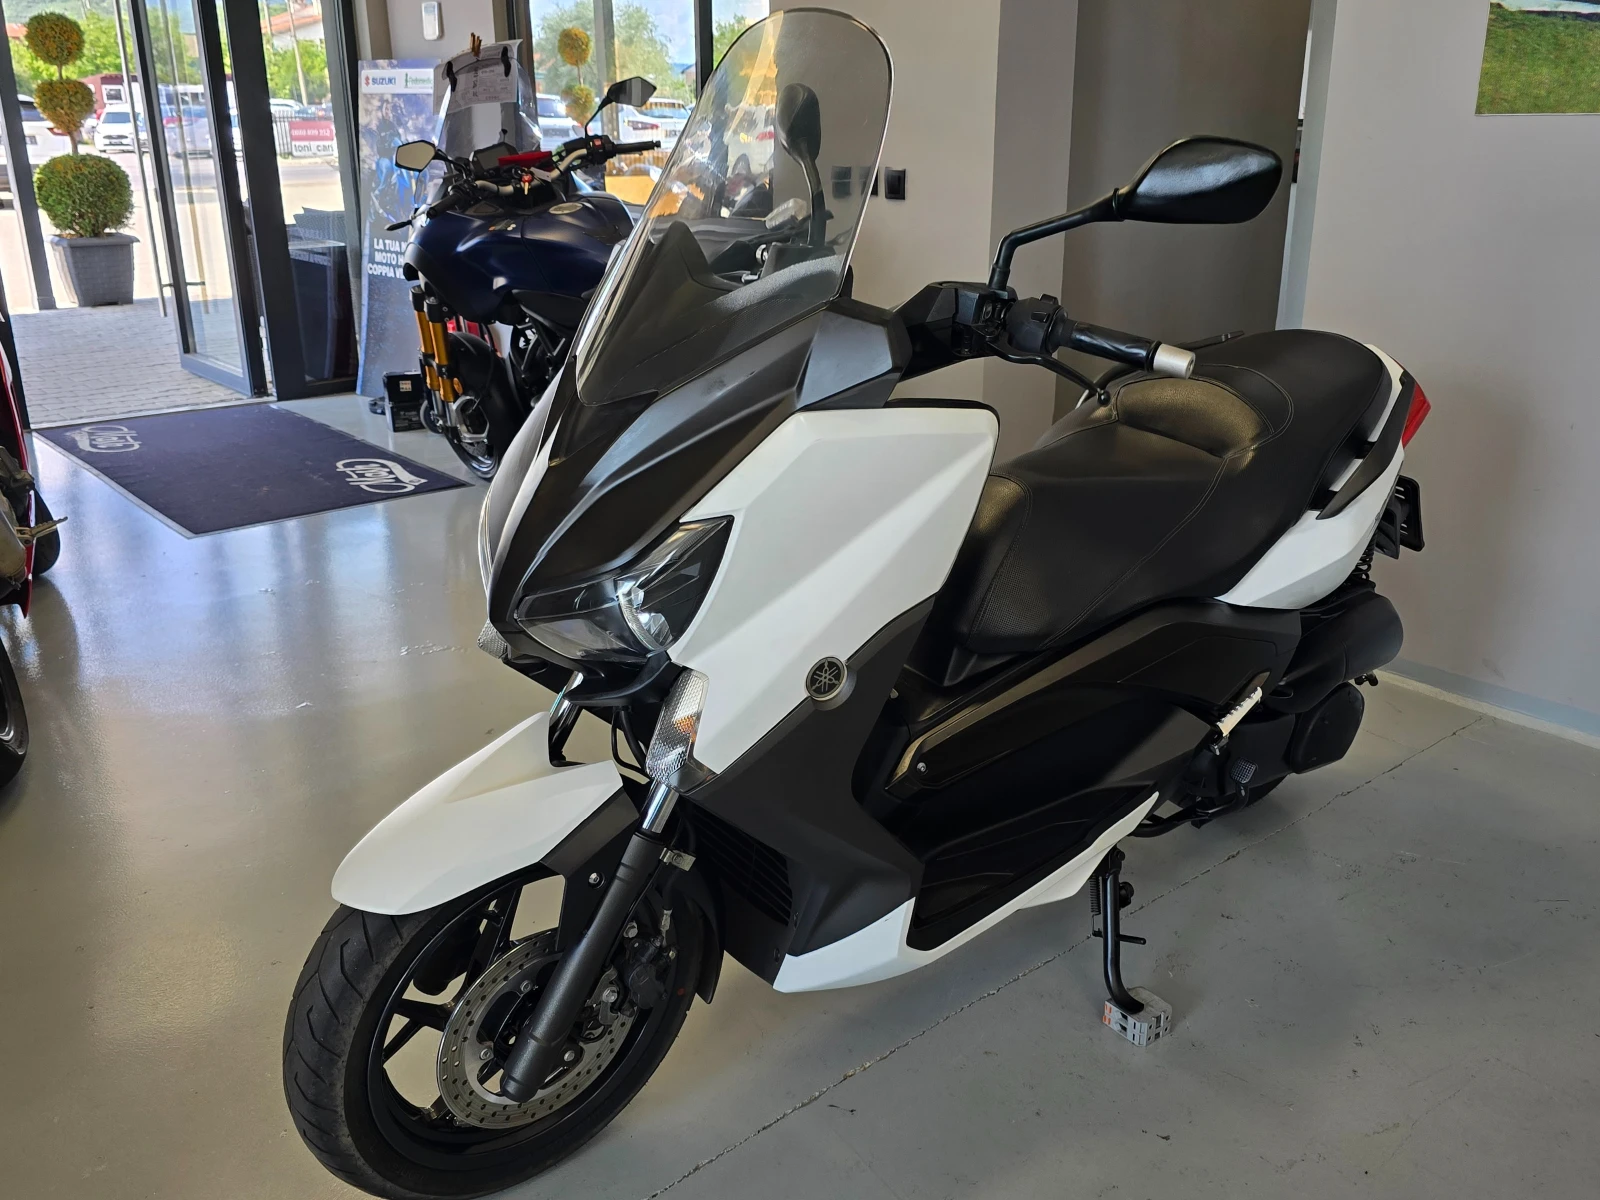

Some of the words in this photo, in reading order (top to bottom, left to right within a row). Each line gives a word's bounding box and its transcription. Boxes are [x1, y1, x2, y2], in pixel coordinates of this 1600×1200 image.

[371, 76, 397, 86] SUZUKI
[373, 237, 384, 250] LA
[384, 239, 400, 252] TUA
[374, 251, 397, 265] MOTO
[367, 262, 395, 278] COPPIA
